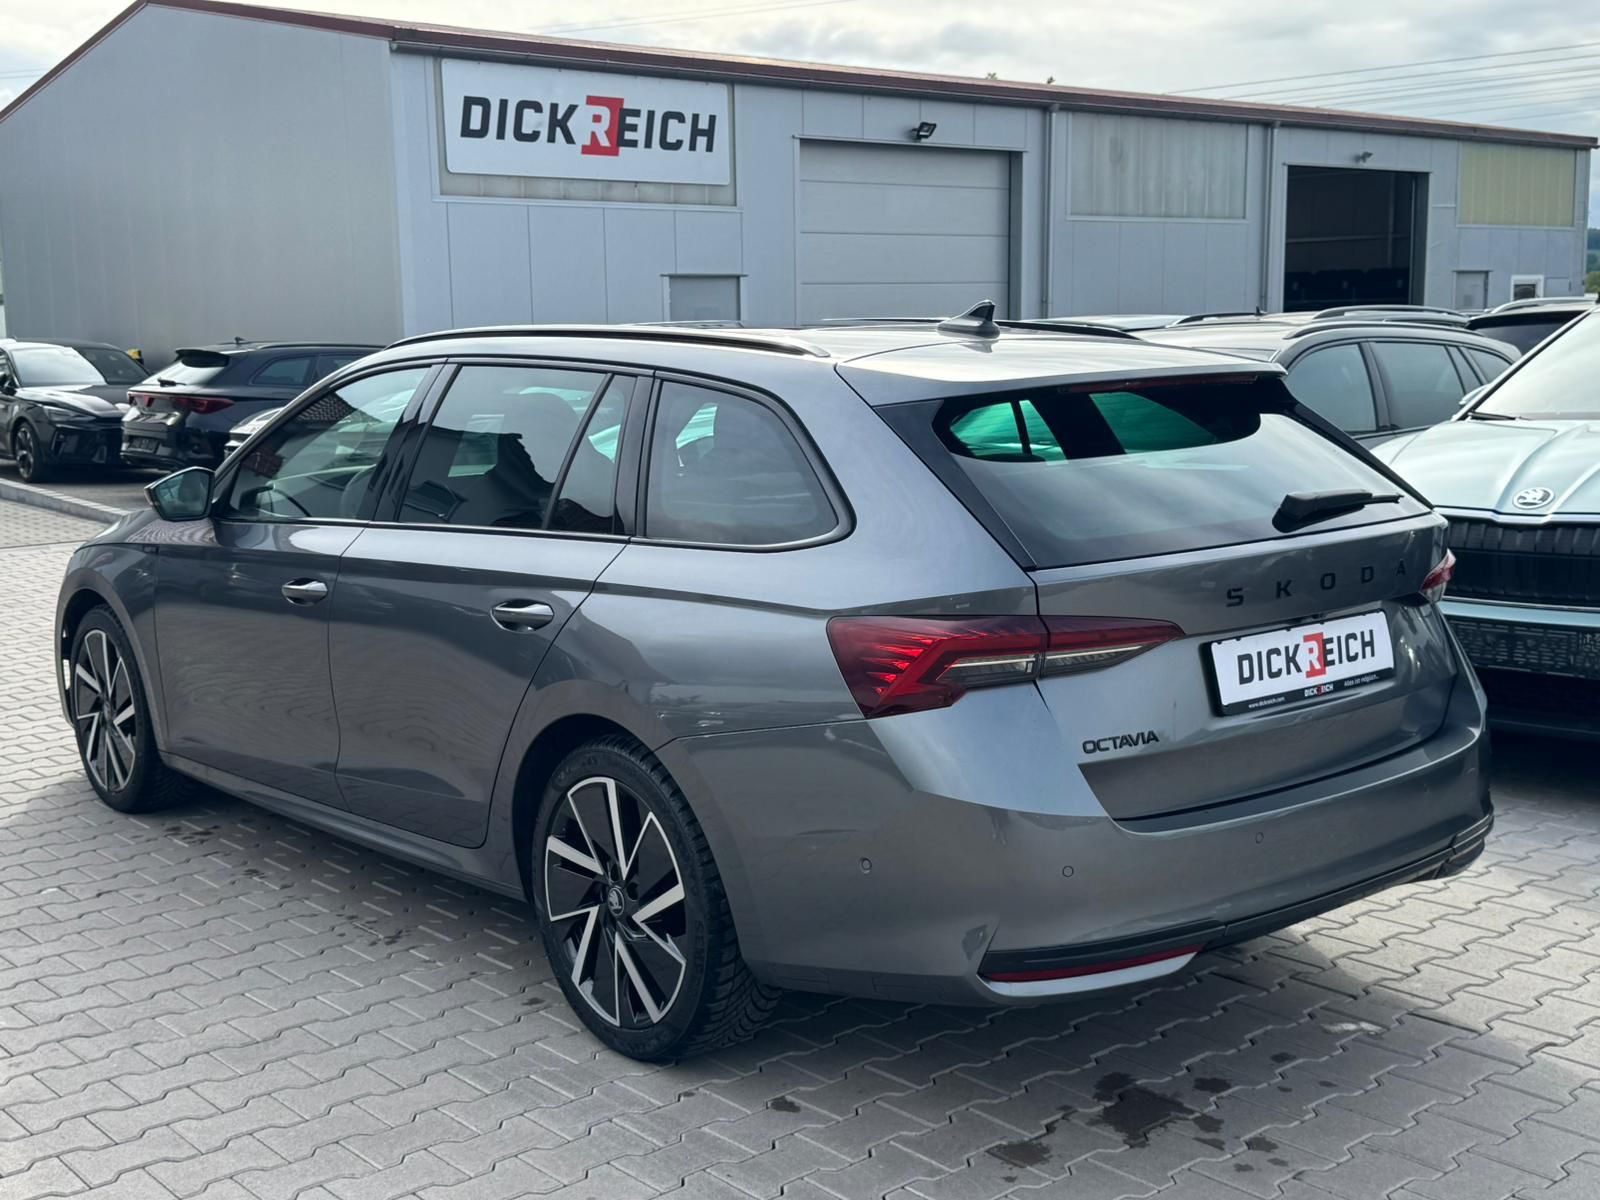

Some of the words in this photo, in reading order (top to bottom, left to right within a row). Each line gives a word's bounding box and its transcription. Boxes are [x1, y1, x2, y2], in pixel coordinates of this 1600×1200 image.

[460, 95, 717, 156] DICKREICH
[1237, 629, 1375, 685] DICKREICH
[1082, 730, 1160, 754] OCTAVIA
